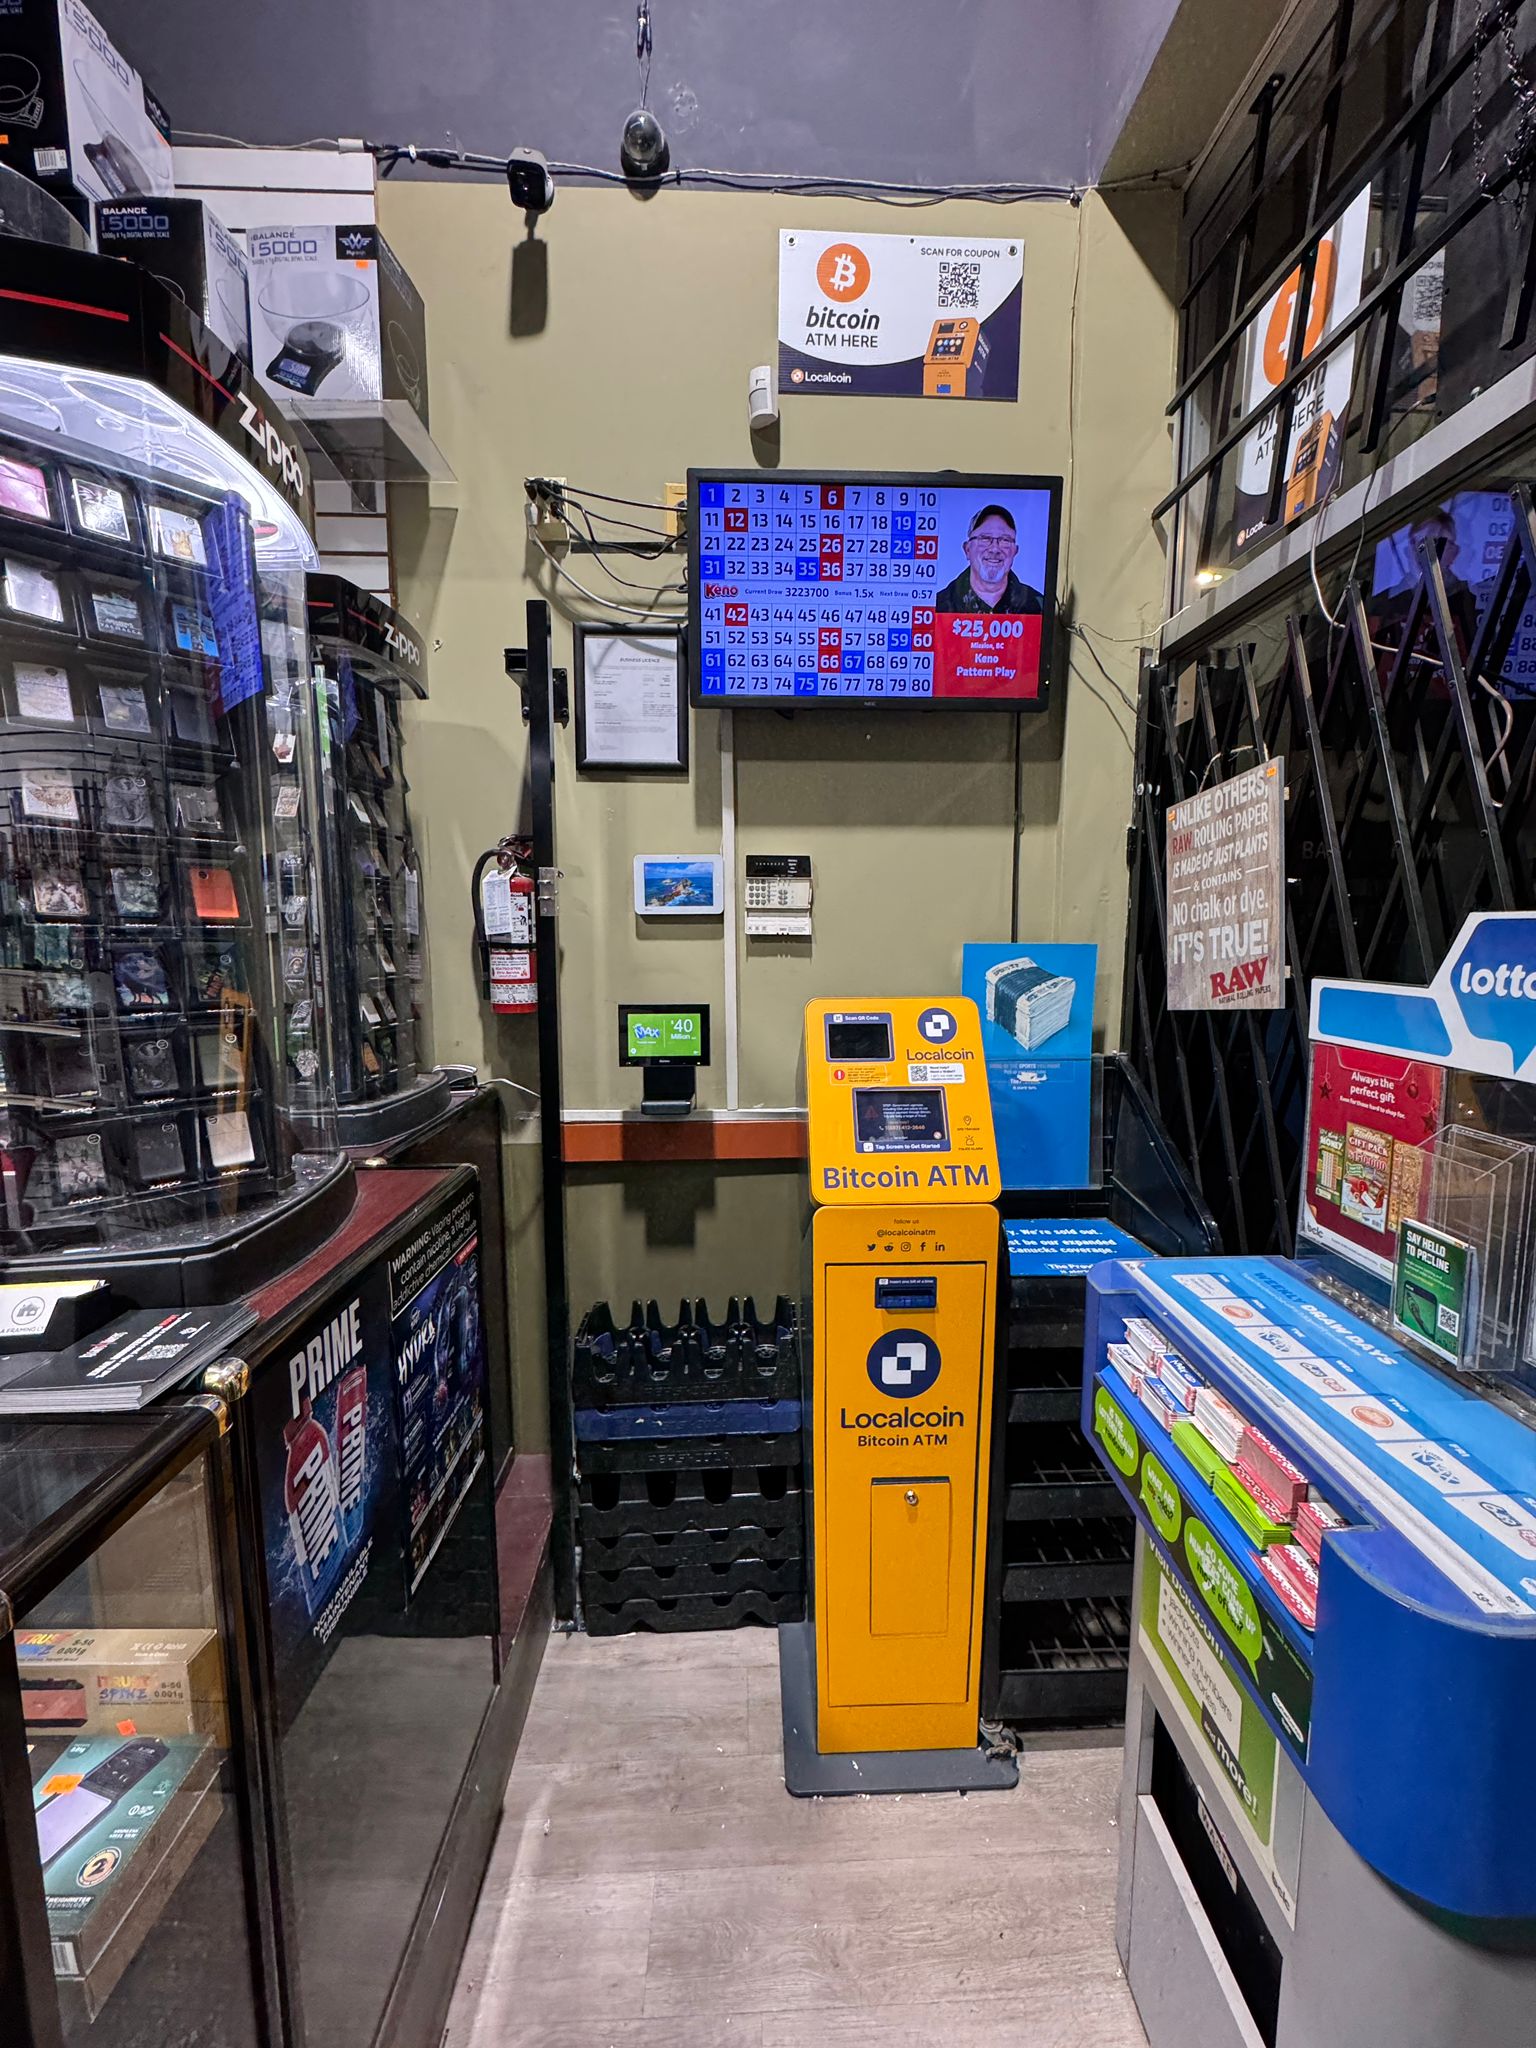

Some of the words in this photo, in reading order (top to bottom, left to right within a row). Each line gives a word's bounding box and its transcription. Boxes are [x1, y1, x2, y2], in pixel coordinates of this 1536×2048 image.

[920, 247, 944, 257] SCAN
[945, 248, 963, 257] FOR
[964, 248, 1001, 259] COUPON
[805, 306, 880, 330] bitcoin
[805, 333, 837, 347] ATM
[841, 334, 879, 348] HERE
[804, 371, 852, 384] Localcoin
[708, 488, 715, 501] 1
[731, 489, 741, 502] 2
[755, 489, 765, 503] 3
[779, 490, 790, 503] 4
[804, 491, 813, 504] 5
[827, 491, 838, 504] 6
[852, 492, 861, 505] 7
[875, 492, 885, 505] 8
[899, 492, 909, 505] 9
[920, 493, 936, 506] 10
[705, 513, 718, 526] 11
[728, 513, 744, 527] 12
[752, 514, 768, 527] 13
[776, 514, 792, 527] 14
[800, 515, 815, 528] 15
[824, 515, 840, 528] 16
[848, 516, 863, 529] 17
[872, 516, 887, 529] 18
[896, 517, 911, 530] 19
[918, 517, 936, 530] 20
[705, 537, 719, 550] 21
[728, 537, 745, 550] 22
[751, 538, 769, 551] 23
[775, 538, 793, 551] 24
[799, 539, 816, 552] 25
[822, 539, 841, 552] 26
[847, 540, 864, 552] 27
[870, 540, 888, 553] 28
[894, 540, 911, 553] 29
[917, 541, 935, 554] 30
[705, 561, 719, 574] 31
[728, 561, 745, 574] 32
[752, 562, 768, 574] 33
[775, 562, 793, 575] 34
[799, 562, 816, 575] 35
[822, 563, 840, 576] 36
[847, 563, 863, 576] 37
[870, 564, 887, 576] 38
[893, 564, 910, 577] 39
[916, 565, 935, 577] 40
[704, 582, 739, 599] Keno
[785, 588, 830, 598] 3223700
[854, 588, 874, 598] 1.5x
[912, 590, 933, 599] 0:57
[952, 618, 1024, 641] $25,000
[974, 653, 999, 664] Keno
[956, 666, 993, 677] Pattern
[995, 667, 1016, 680] Play
[1172, 794, 1212, 832] UNLIKE
[1214, 770, 1269, 815] OTHERS,
[1172, 830, 1193, 856] RAW
[1193, 814, 1233, 849] ROLLING
[1234, 802, 1269, 836] PAPER
[1172, 862, 1181, 879] IS
[1180, 855, 1202, 878] MADE
[1201, 851, 1213, 869] OF
[1213, 844, 1235, 867] JUST
[1234, 830, 1268, 860] PLANTS
[1192, 880, 1200, 892] &
[1201, 867, 1242, 890] CONTAINS
[1172, 902, 1188, 928] NO
[1190, 891, 1222, 922] chalk
[1223, 896, 1238, 916] or
[1240, 884, 1269, 914] dye.
[1173, 930, 1205, 965] IT'S
[1208, 918, 1269, 961] TRUE!
[1210, 956, 1269, 999] RAW
[906, 1047, 975, 1061] Localcoin
[1351, 1071, 1380, 1088] Always
[1379, 1078, 1395, 1090] the
[1350, 1084, 1379, 1100] perfect
[1379, 1090, 1396, 1104] gift
[1320, 1136, 1343, 1150] MONEY
[1349, 1136, 1368, 1149] GIFT
[1367, 1142, 1388, 1157] PACK
[823, 1164, 919, 1189] Bitcoin
[927, 1164, 990, 1186] ATM
[392, 1231, 432, 1274] WARNING:
[431, 1212, 451, 1236] Vaping
[451, 1191, 475, 1221] products
[876, 1228, 936, 1239] @localcoinatm
[1061, 1239, 1118, 1247] expanded
[1406, 1230, 1421, 1243] SAY
[1421, 1236, 1446, 1258] HELLO
[401, 1254, 427, 1285] contain
[426, 1231, 451, 1260] nicotine,
[450, 1225, 456, 1234] a
[455, 1209, 471, 1233] highly
[1059, 1247, 1118, 1255] coverage.
[1406, 1242, 1416, 1257] TO
[393, 1273, 425, 1311] addictive
[1254, 1272, 1306, 1303] WEEKLY
[1300, 1303, 1353, 1336] DRAW
[1350, 1335, 1399, 1365] DAYS
[288, 1297, 364, 1420] PRIME
[840, 1405, 965, 1429] Localcoin
[858, 1435, 909, 1447] Bitcoin
[913, 1434, 948, 1446] ATM
[341, 1401, 363, 1517] PRIME
[293, 1441, 339, 1581] PRIME
[313, 1599, 335, 1638] NOW
[334, 1536, 374, 1604] AVAILABLE
[1216, 1738, 1257, 1816] more!
